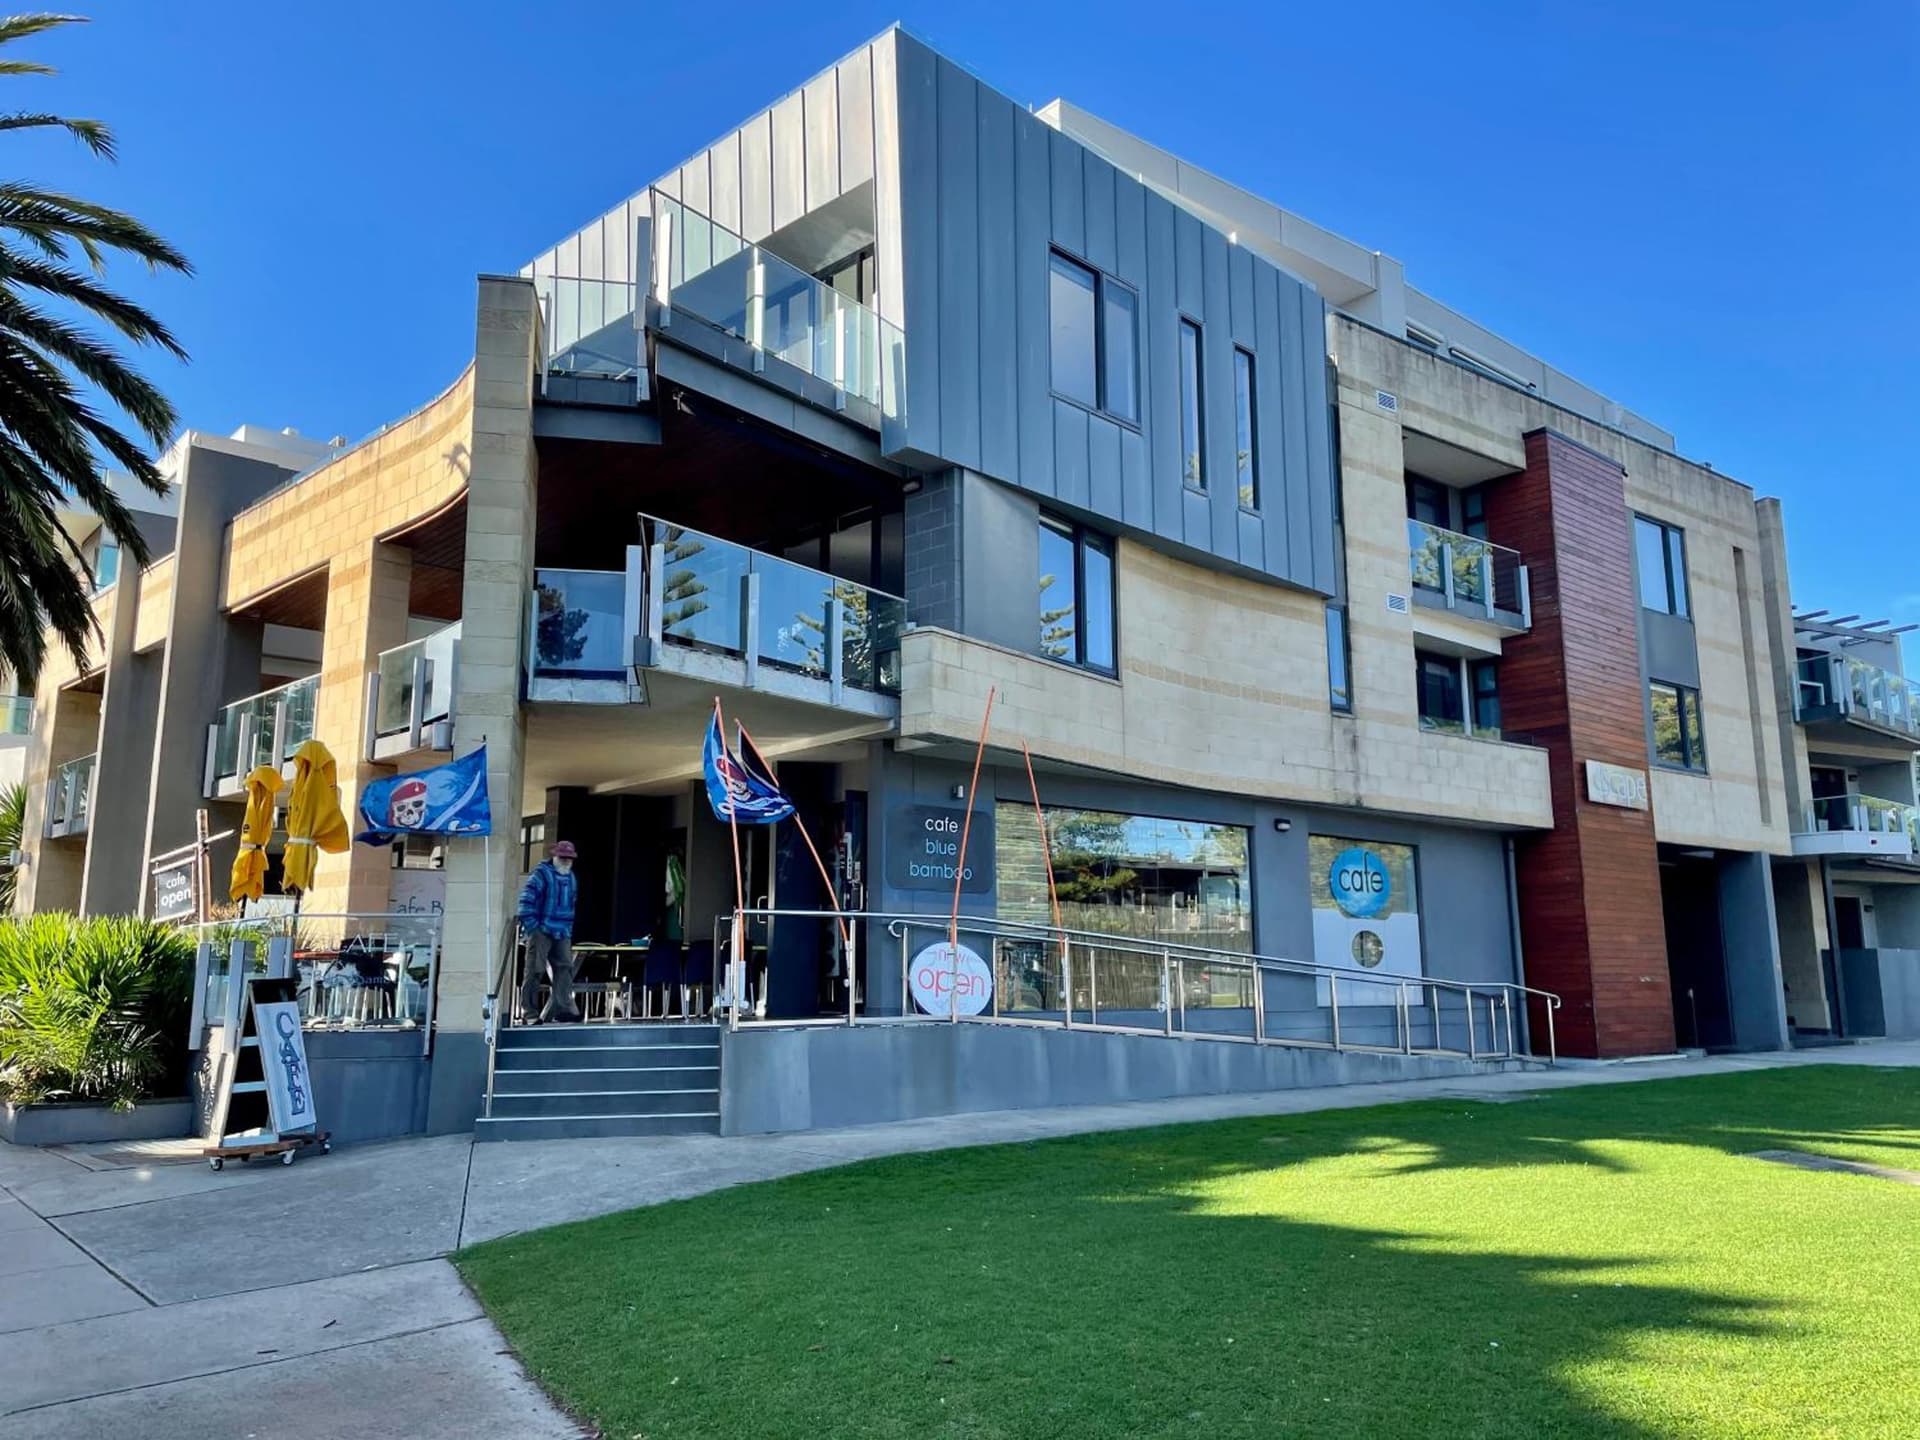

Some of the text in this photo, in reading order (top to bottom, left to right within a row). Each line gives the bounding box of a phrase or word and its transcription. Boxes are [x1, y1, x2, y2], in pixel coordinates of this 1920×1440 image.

[924, 816, 959, 833] cafe
[925, 838, 957, 856] blue
[166, 871, 186, 889] cafe
[909, 861, 973, 881] bamboo
[1338, 851, 1384, 893] cafe
[160, 888, 192, 908] open
[934, 948, 966, 963] nw
[918, 968, 985, 998] open
[275, 1011, 306, 1116] CAFE
